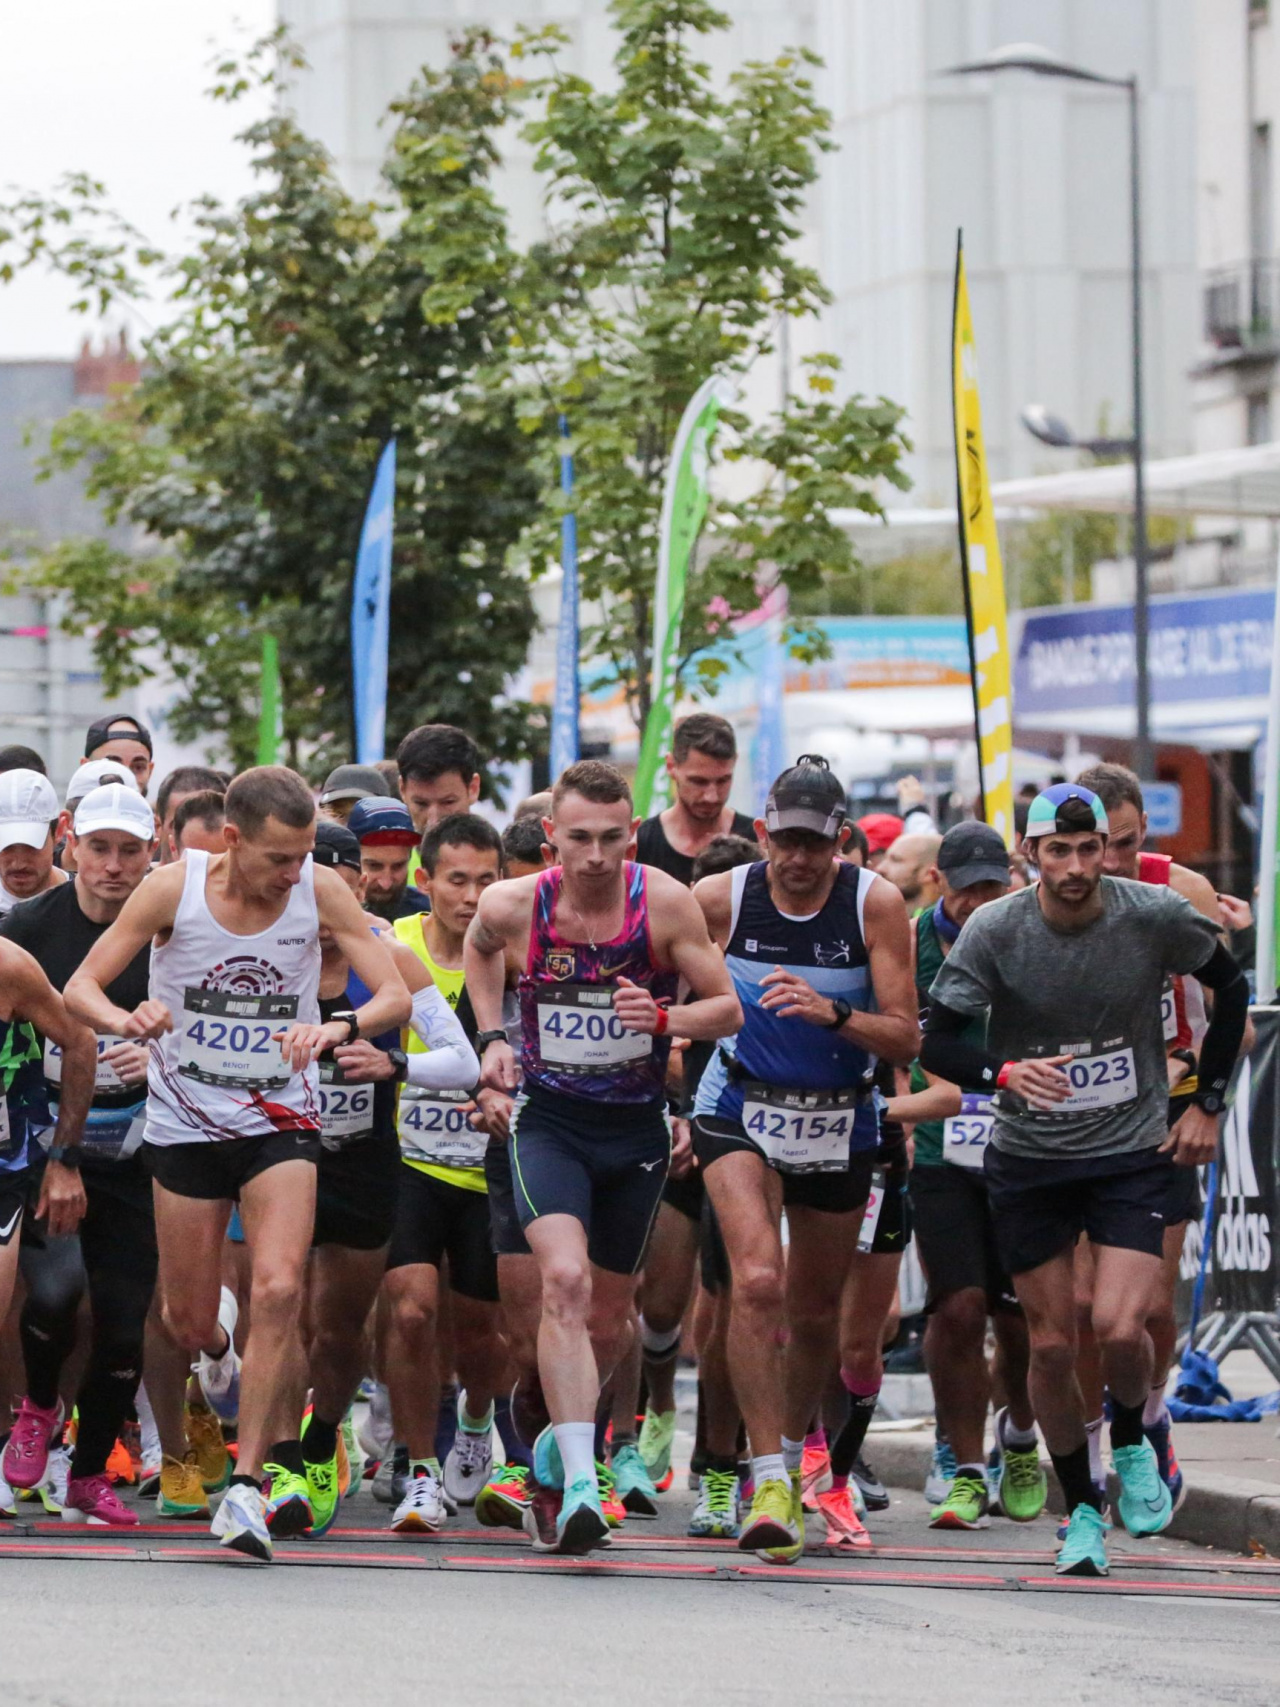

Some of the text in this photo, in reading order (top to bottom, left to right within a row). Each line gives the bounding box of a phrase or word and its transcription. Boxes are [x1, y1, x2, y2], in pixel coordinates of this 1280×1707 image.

[277, 938, 306, 946] GAUTIER
[544, 1011, 645, 1041] 4200
[222, 1061, 250, 1070] BENOIT
[1055, 1056, 1131, 1089] 023
[747, 1109, 848, 1140] 42154
